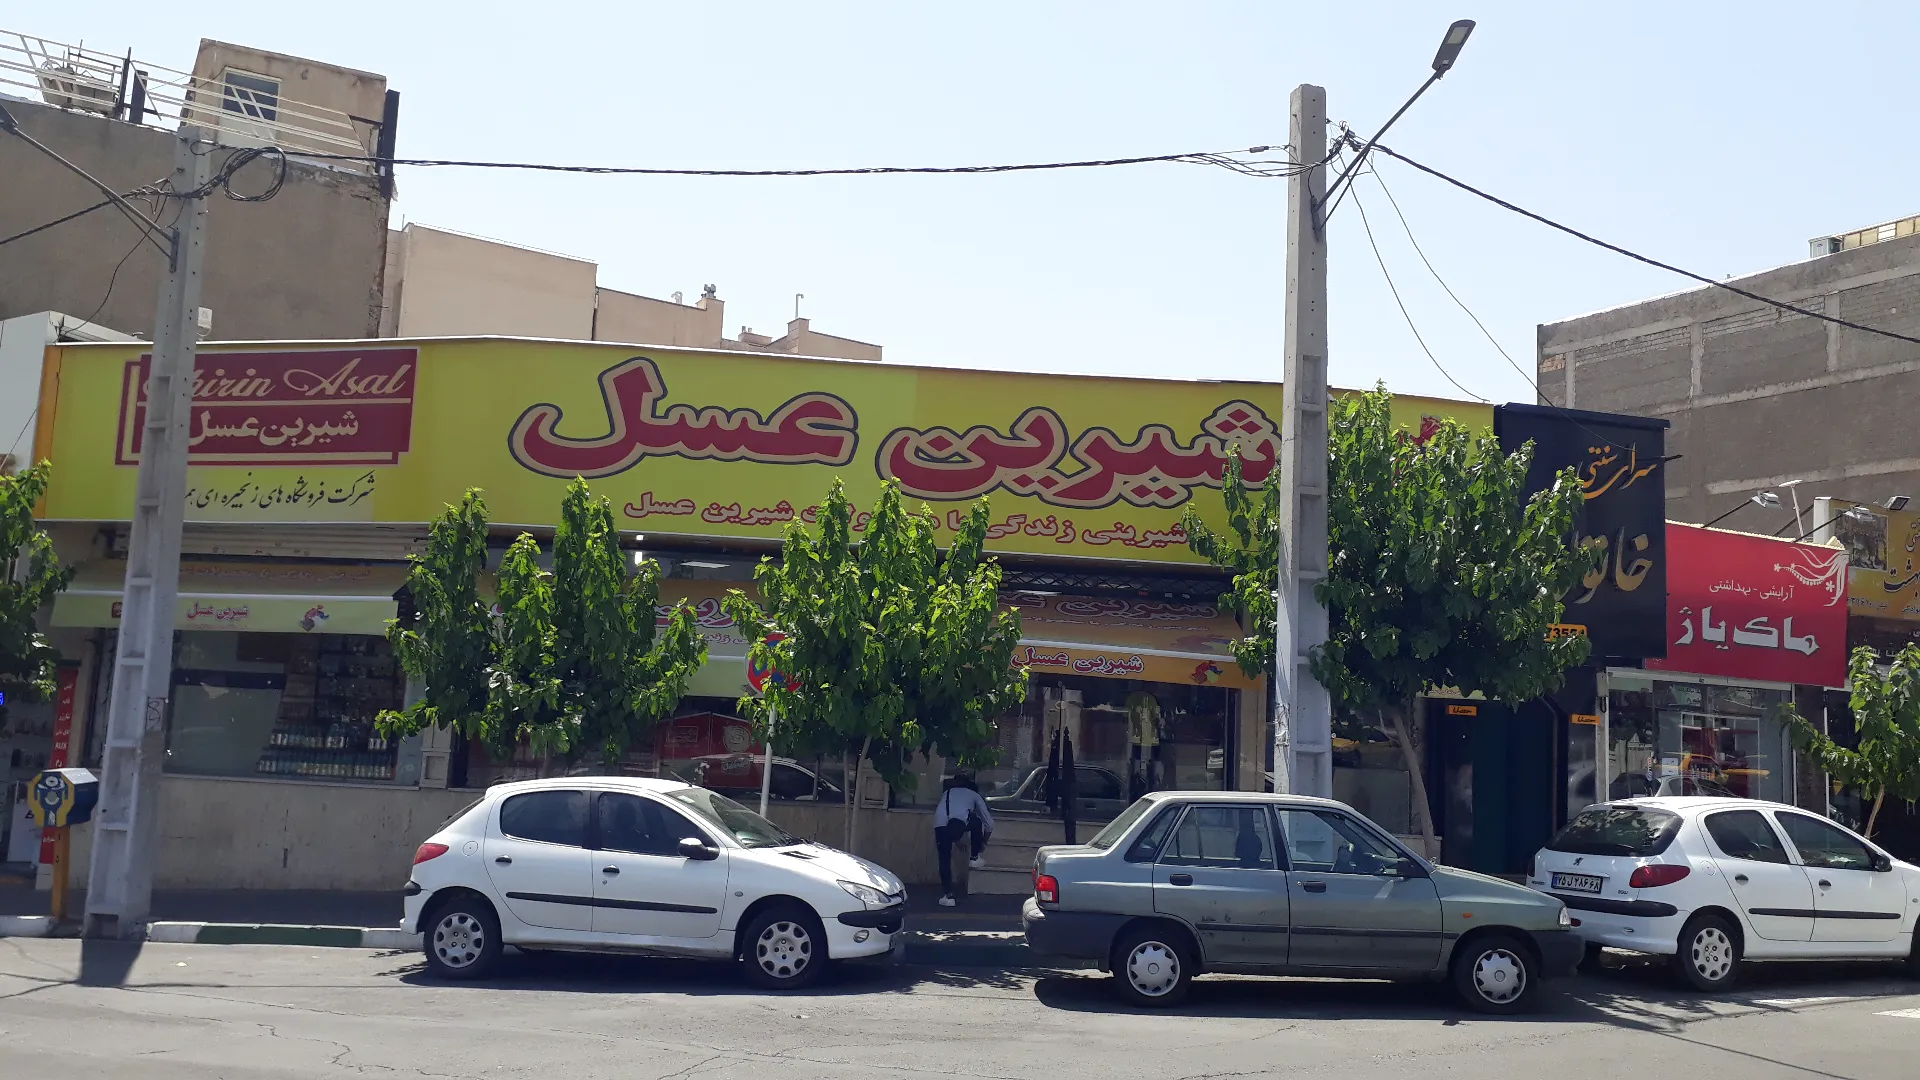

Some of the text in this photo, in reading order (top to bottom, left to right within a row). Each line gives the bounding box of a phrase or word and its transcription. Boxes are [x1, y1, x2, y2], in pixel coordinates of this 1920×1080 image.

[284, 357, 411, 397] Asal
[189, 410, 359, 447] شیرین عسل
[508, 356, 1283, 509] شیرین عسل
[285, 476, 325, 508] فروشگاه
[327, 470, 375, 507] شرکت
[623, 490, 697, 518] عسل
[701, 499, 795, 526] شیرین
[1081, 521, 1188, 548] شیرینی
[1709, 579, 1752, 597] بهداشتی
[1759, 585, 1795, 602] آرایشی
[186, 602, 215, 620] عسل
[1010, 647, 1144, 675] شیرین عسل
